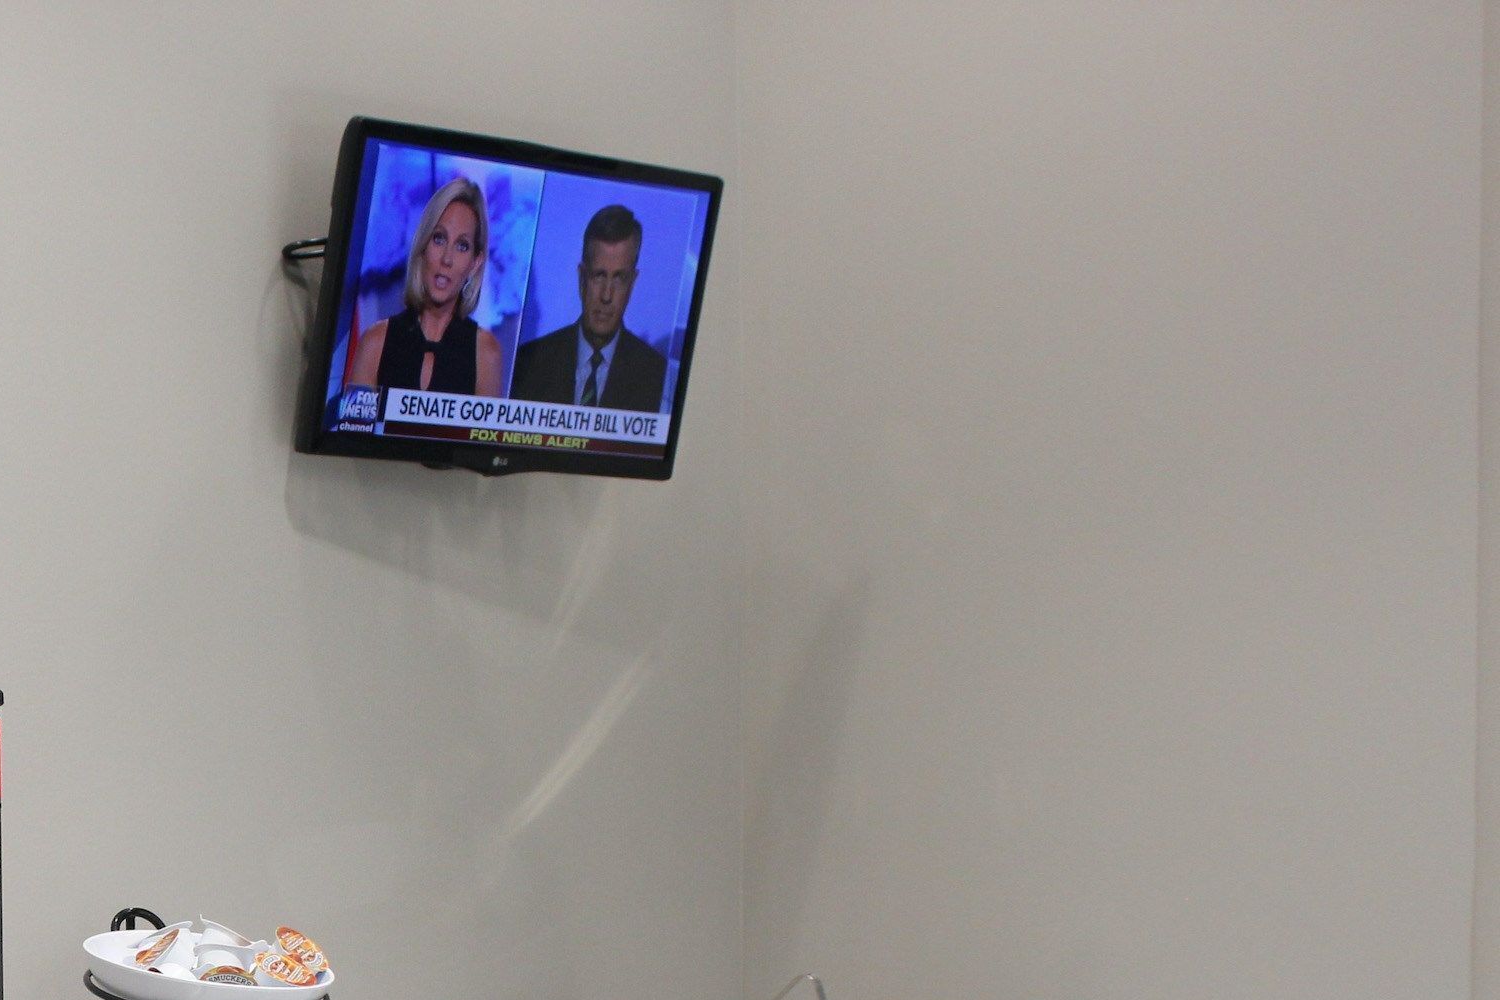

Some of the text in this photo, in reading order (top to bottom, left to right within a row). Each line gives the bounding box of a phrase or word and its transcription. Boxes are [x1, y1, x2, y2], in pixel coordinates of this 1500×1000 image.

[356, 391, 379, 405] FOX
[346, 404, 377, 420] NEWS
[400, 395, 659, 437] SENATE GOP PLAN HEALTH BILL VOTE
[339, 421, 374, 433] channel
[468, 429, 591, 450] FOX NEWS ALERT
